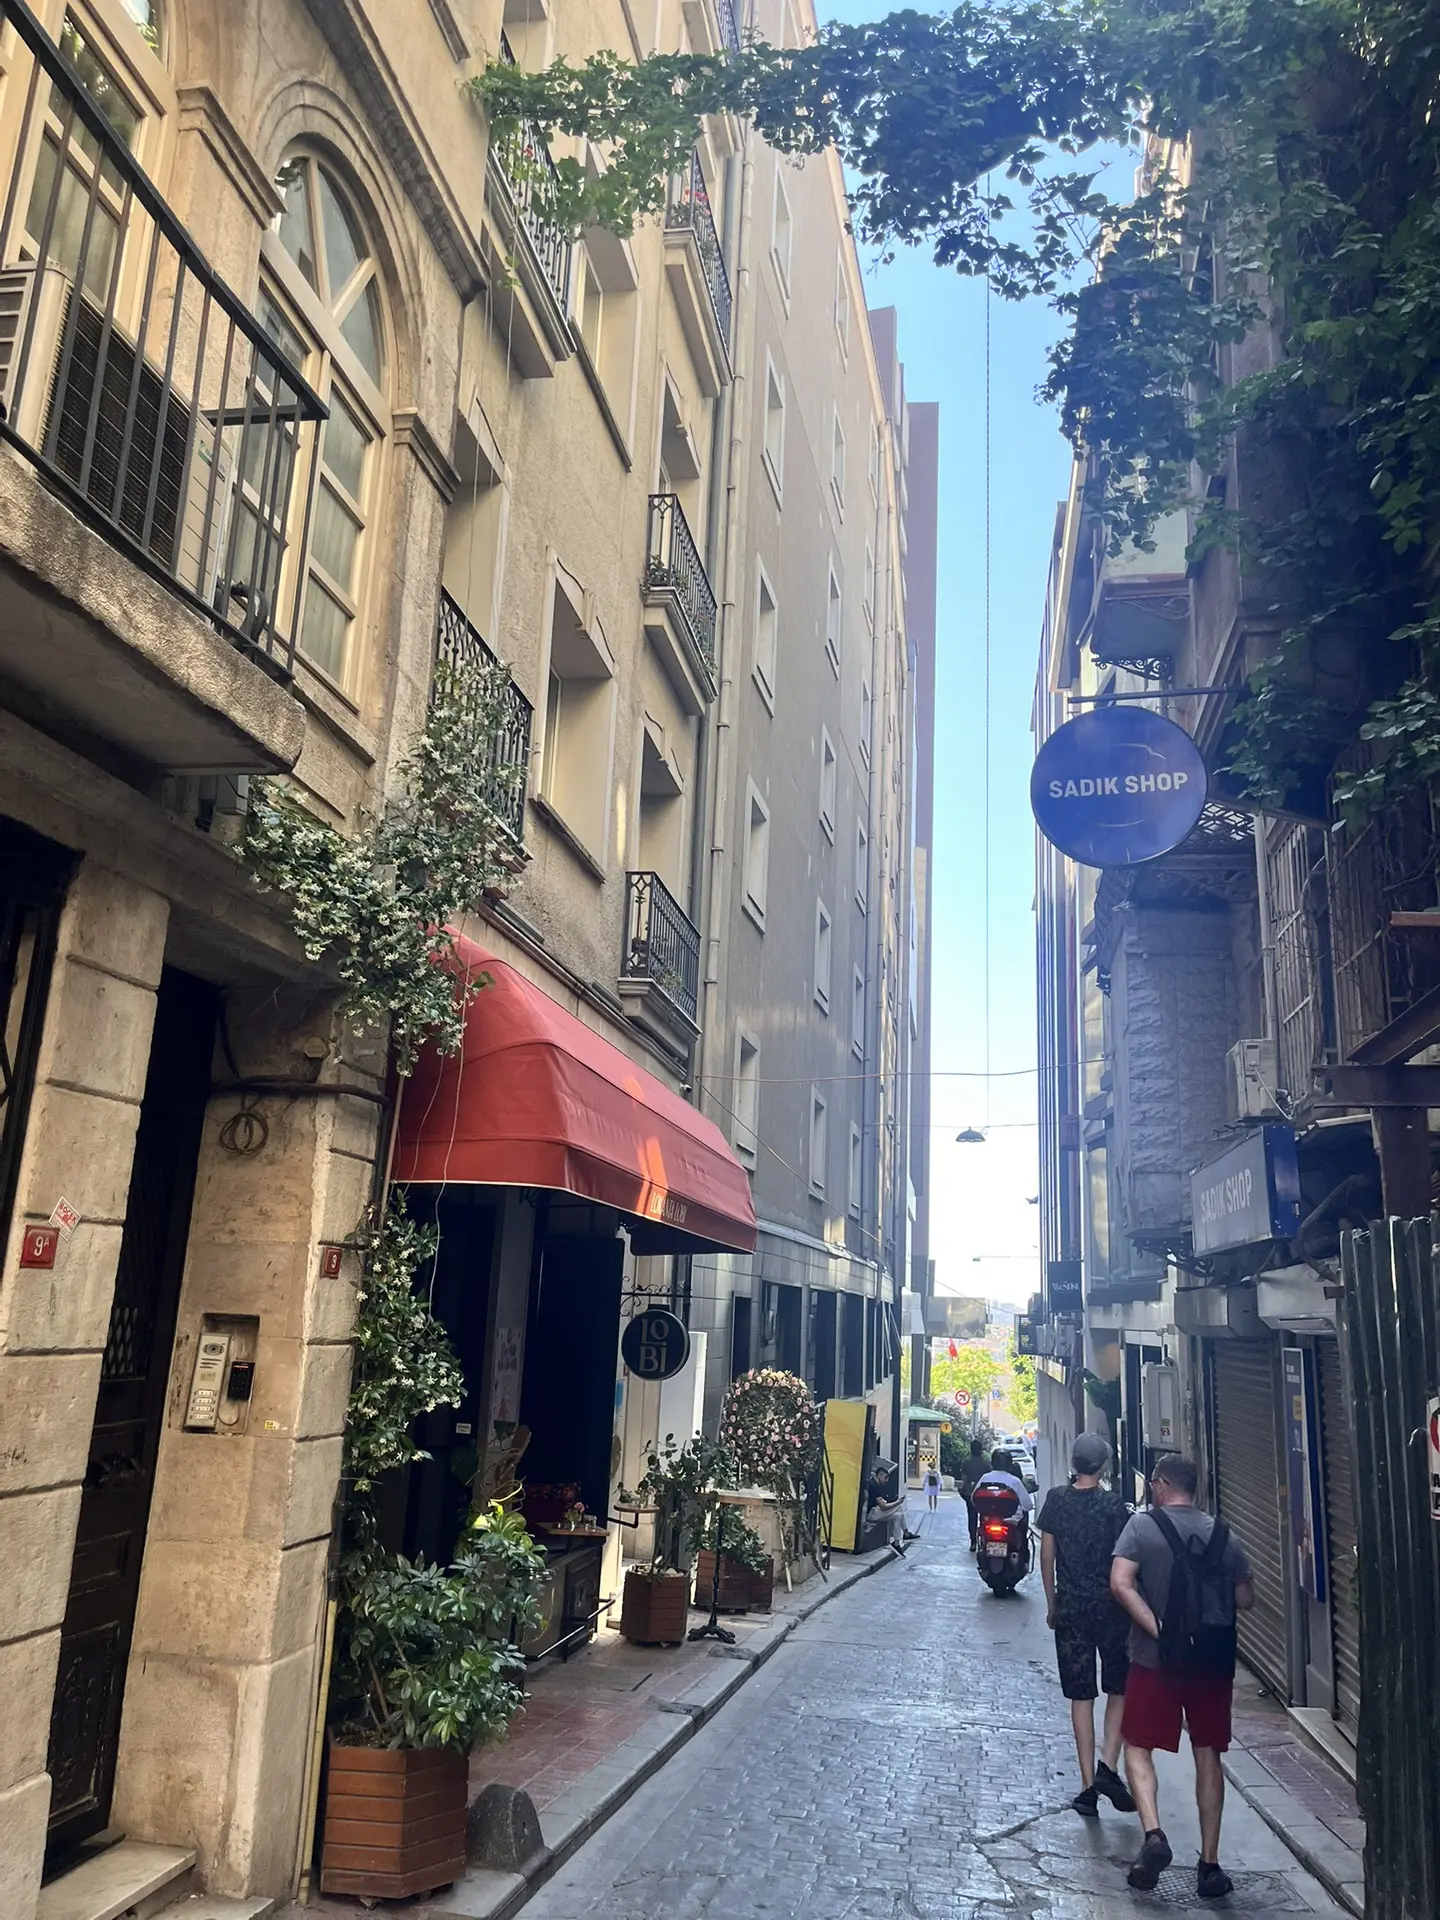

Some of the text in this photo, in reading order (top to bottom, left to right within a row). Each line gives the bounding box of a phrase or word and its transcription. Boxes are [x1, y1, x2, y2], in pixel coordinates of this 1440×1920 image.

[1049, 771, 1188, 799] SADIK SHOP
[1200, 1168, 1252, 1224] SADIK SHOP
[331, 1254, 338, 1269] 9
[641, 1318, 669, 1345] LO
